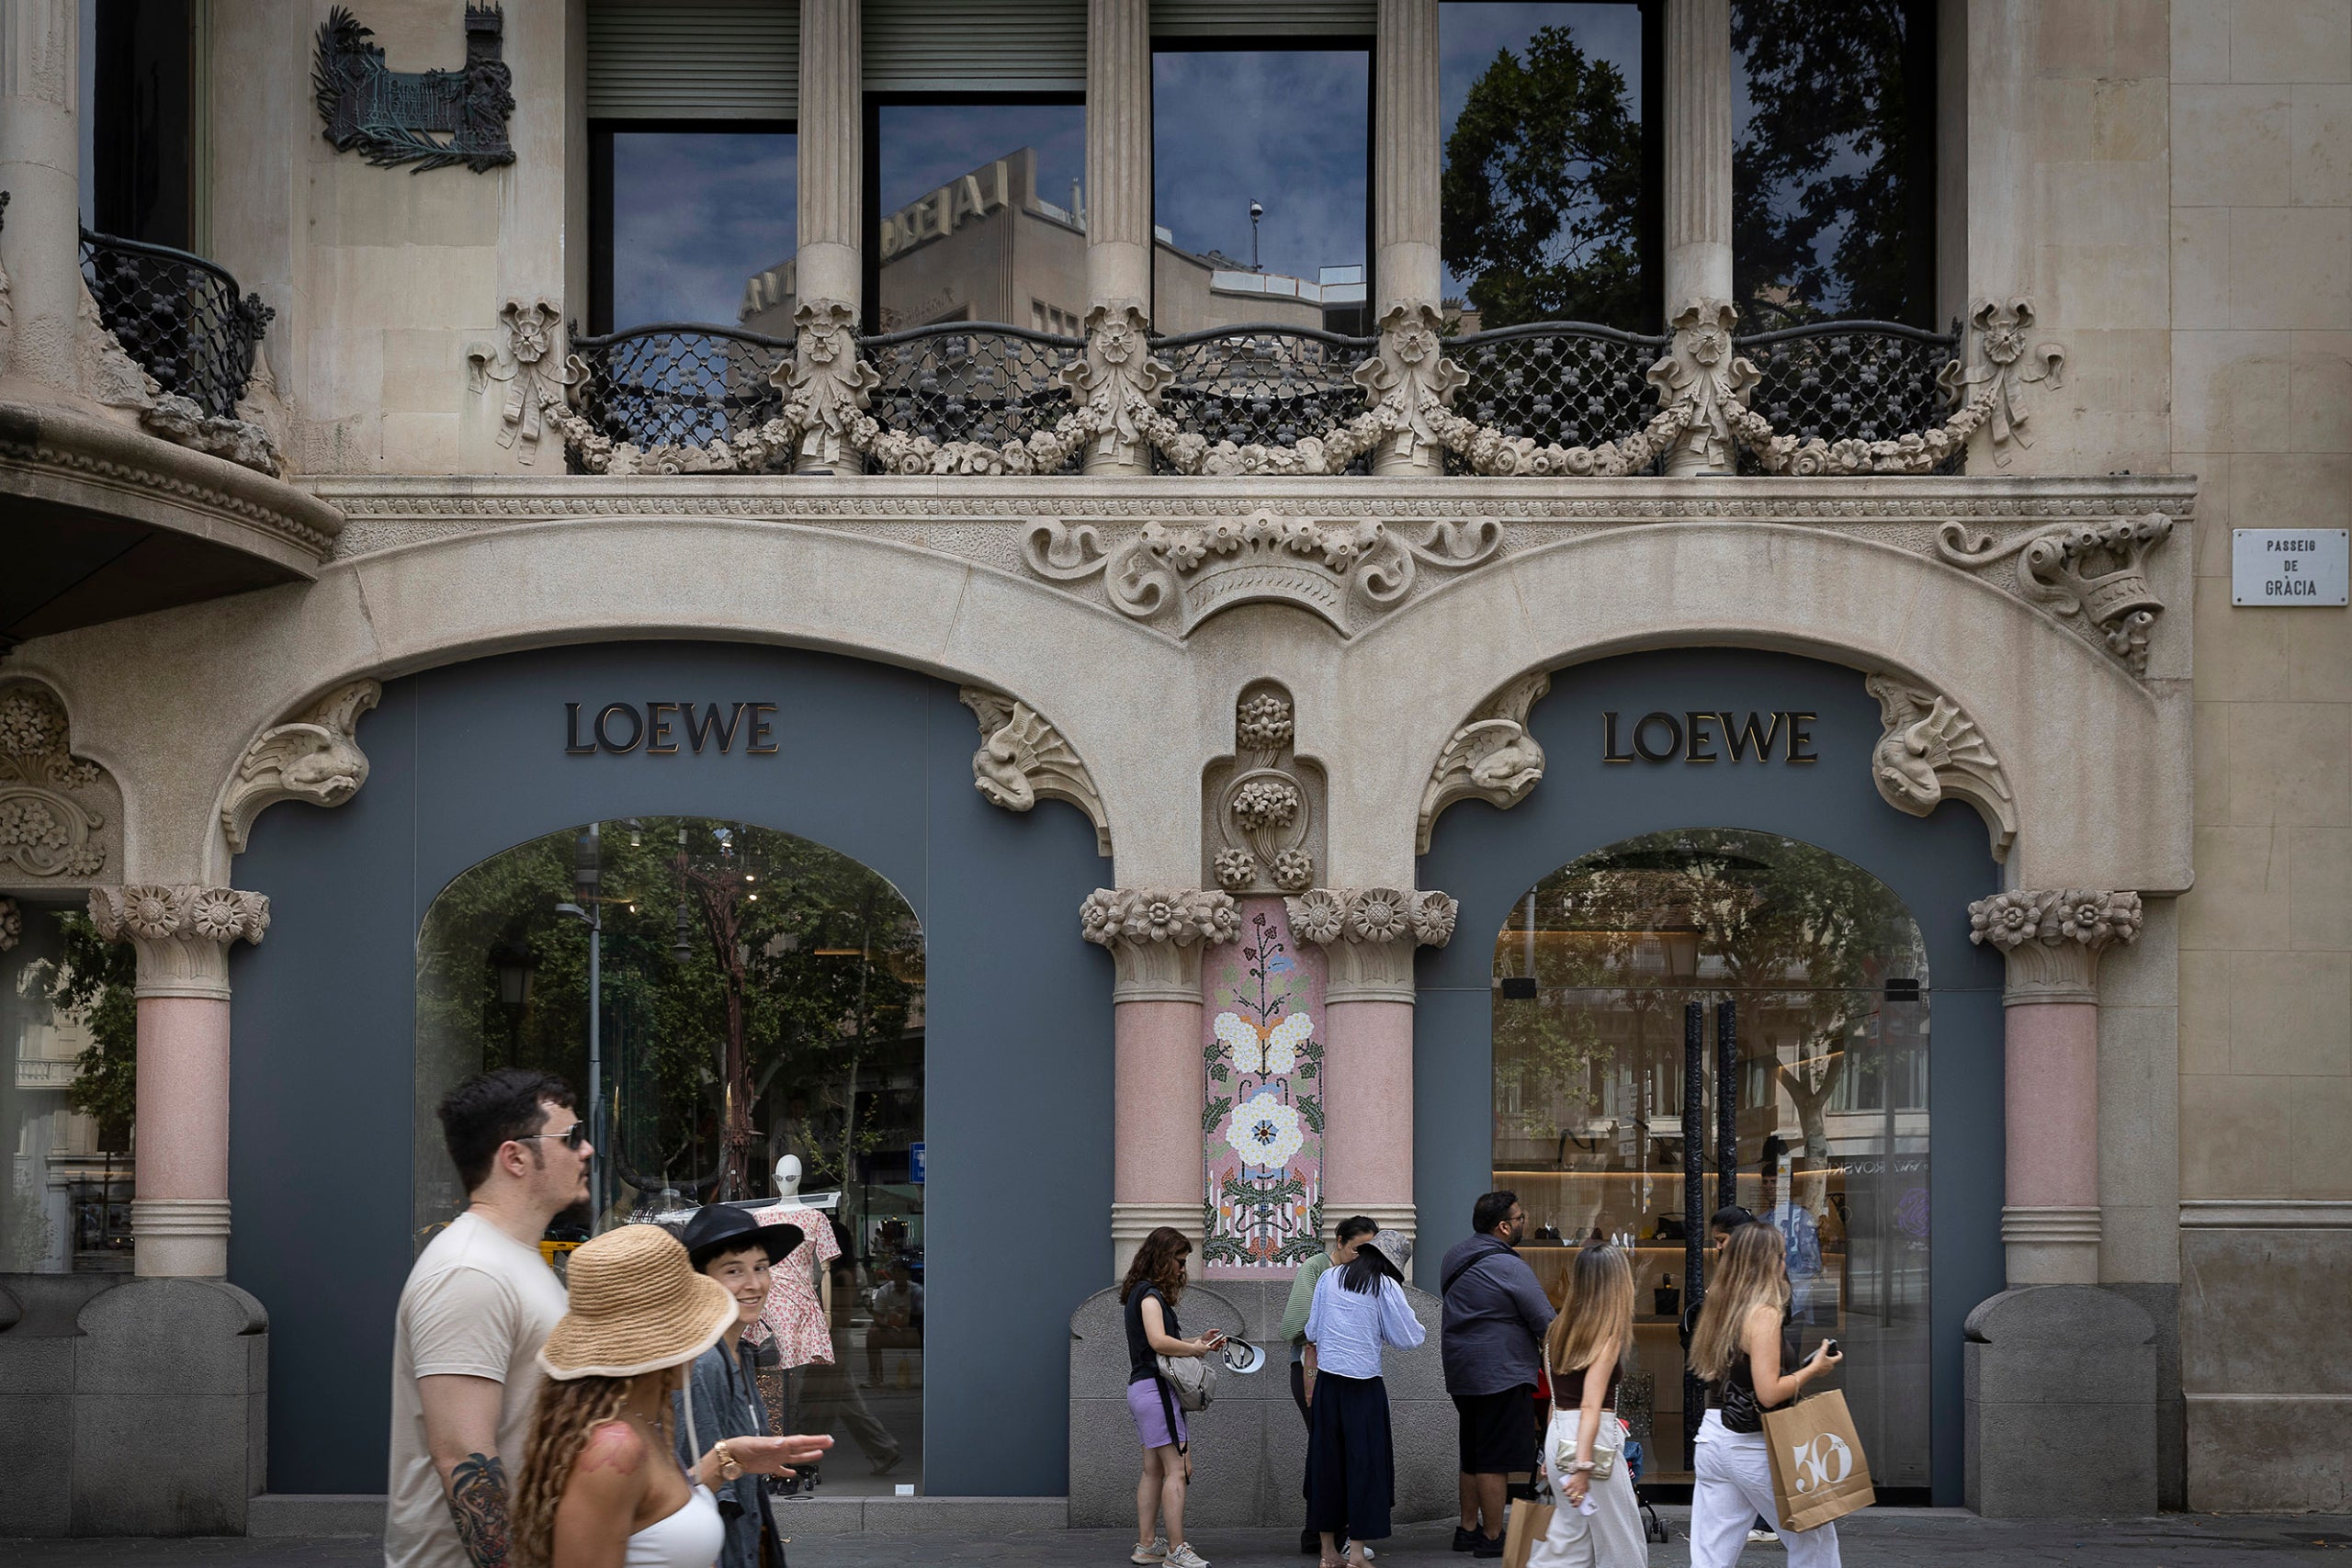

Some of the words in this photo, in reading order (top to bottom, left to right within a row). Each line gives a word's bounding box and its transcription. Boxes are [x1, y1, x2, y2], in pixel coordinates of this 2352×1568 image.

[2267, 540, 2315, 552] PASSEIG
[2284, 559, 2299, 572] DE
[2265, 575, 2317, 596] GRÀCIA
[564, 702, 780, 754] LOEWE
[1602, 711, 1819, 763] LOEWE
[1793, 1432, 1853, 1494] 50
